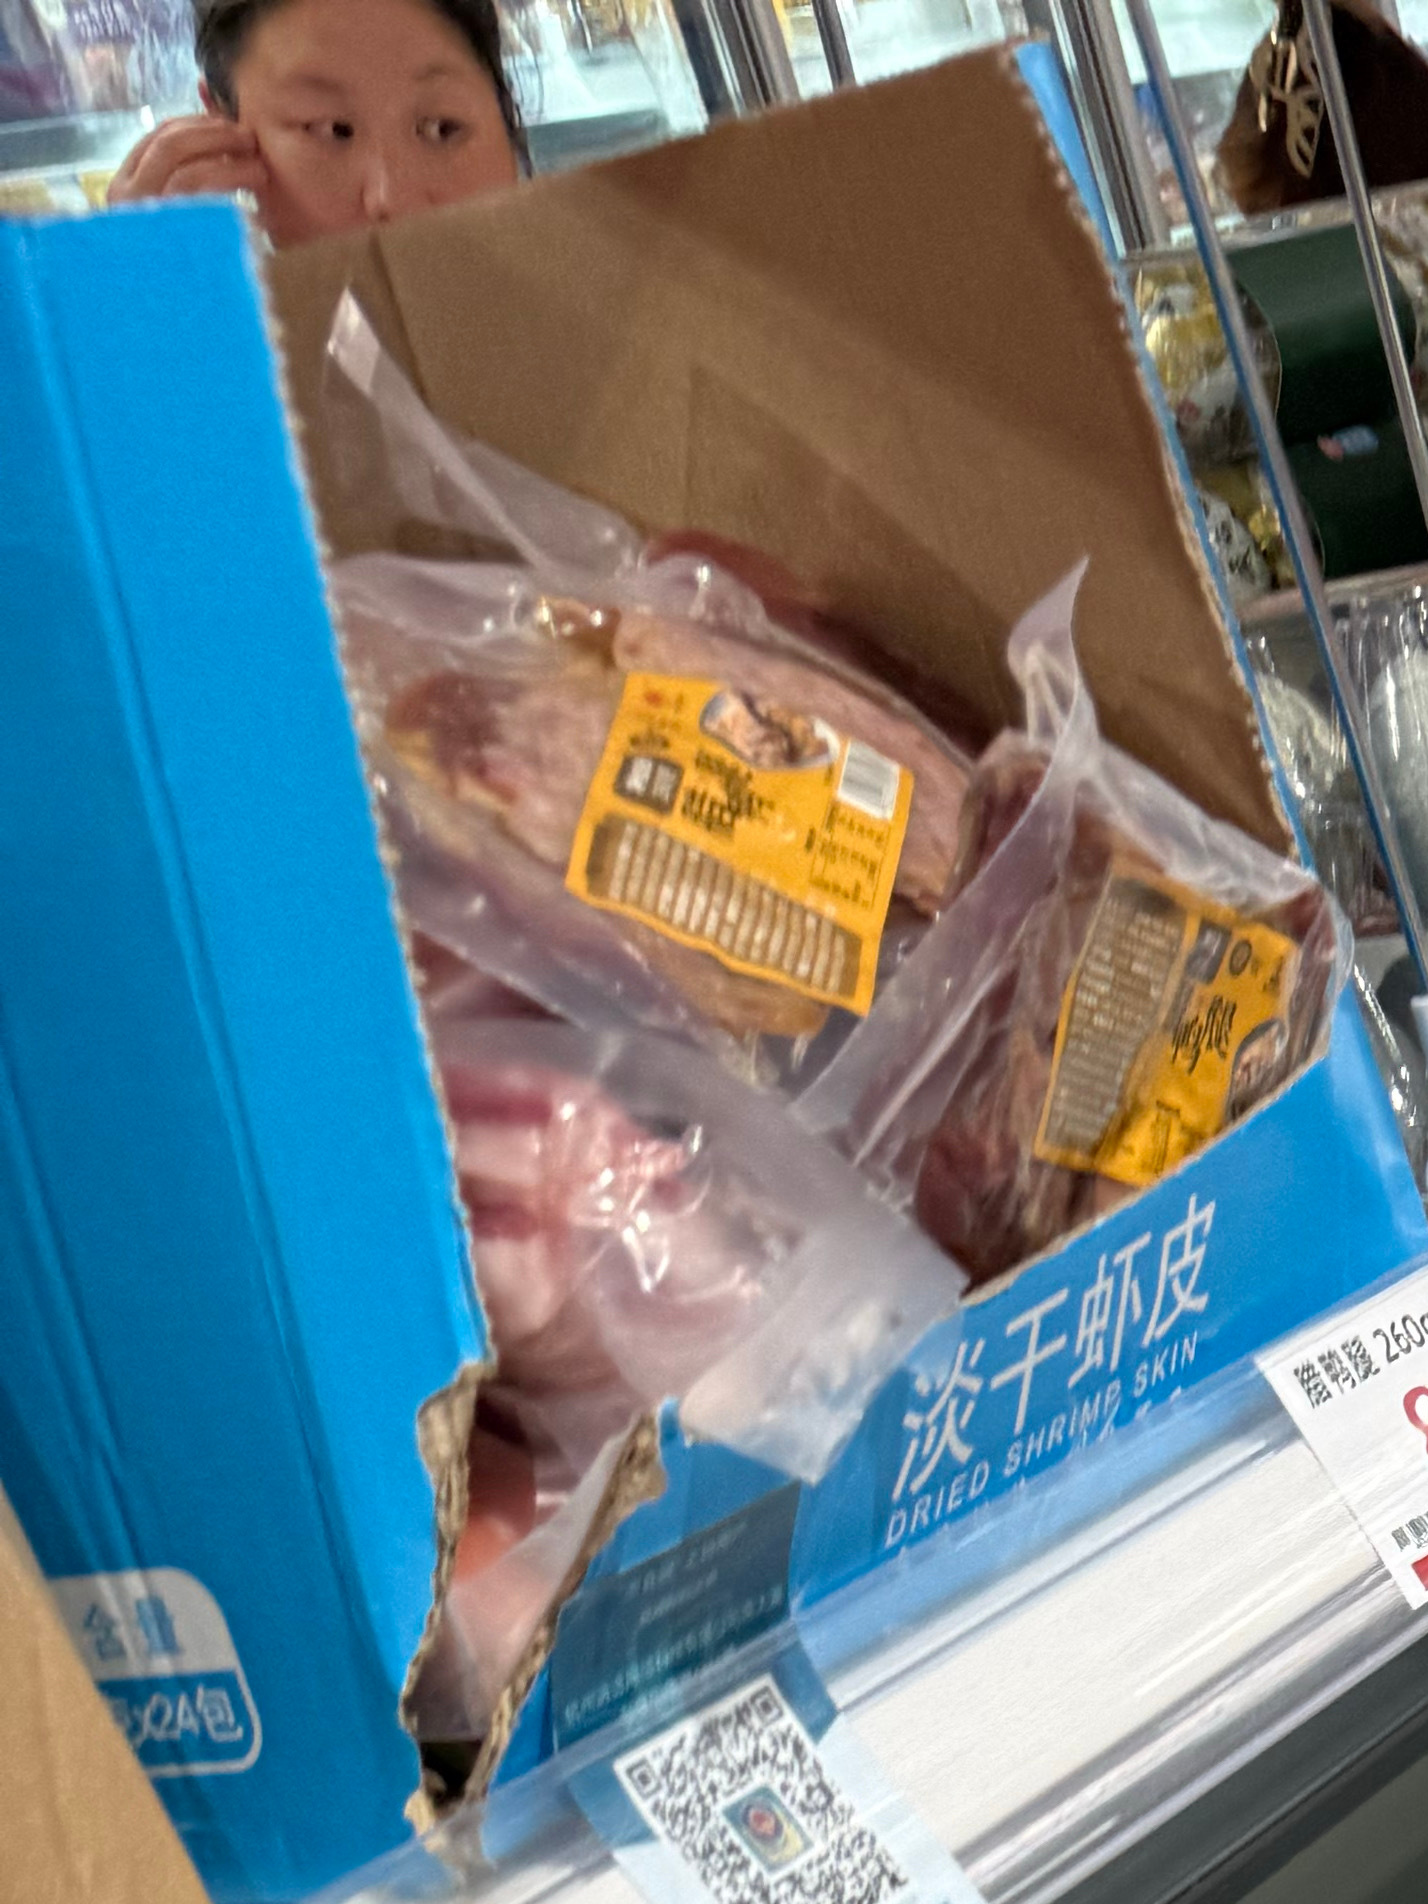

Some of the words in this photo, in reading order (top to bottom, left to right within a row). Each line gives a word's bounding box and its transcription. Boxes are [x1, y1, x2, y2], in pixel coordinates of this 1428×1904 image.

[884, 1460, 990, 1549] DRIED
[1004, 1379, 1122, 1477] SHRIMP
[1133, 1330, 1199, 1400] SKIN
[892, 1193, 1216, 1503] 淡干虾皮
